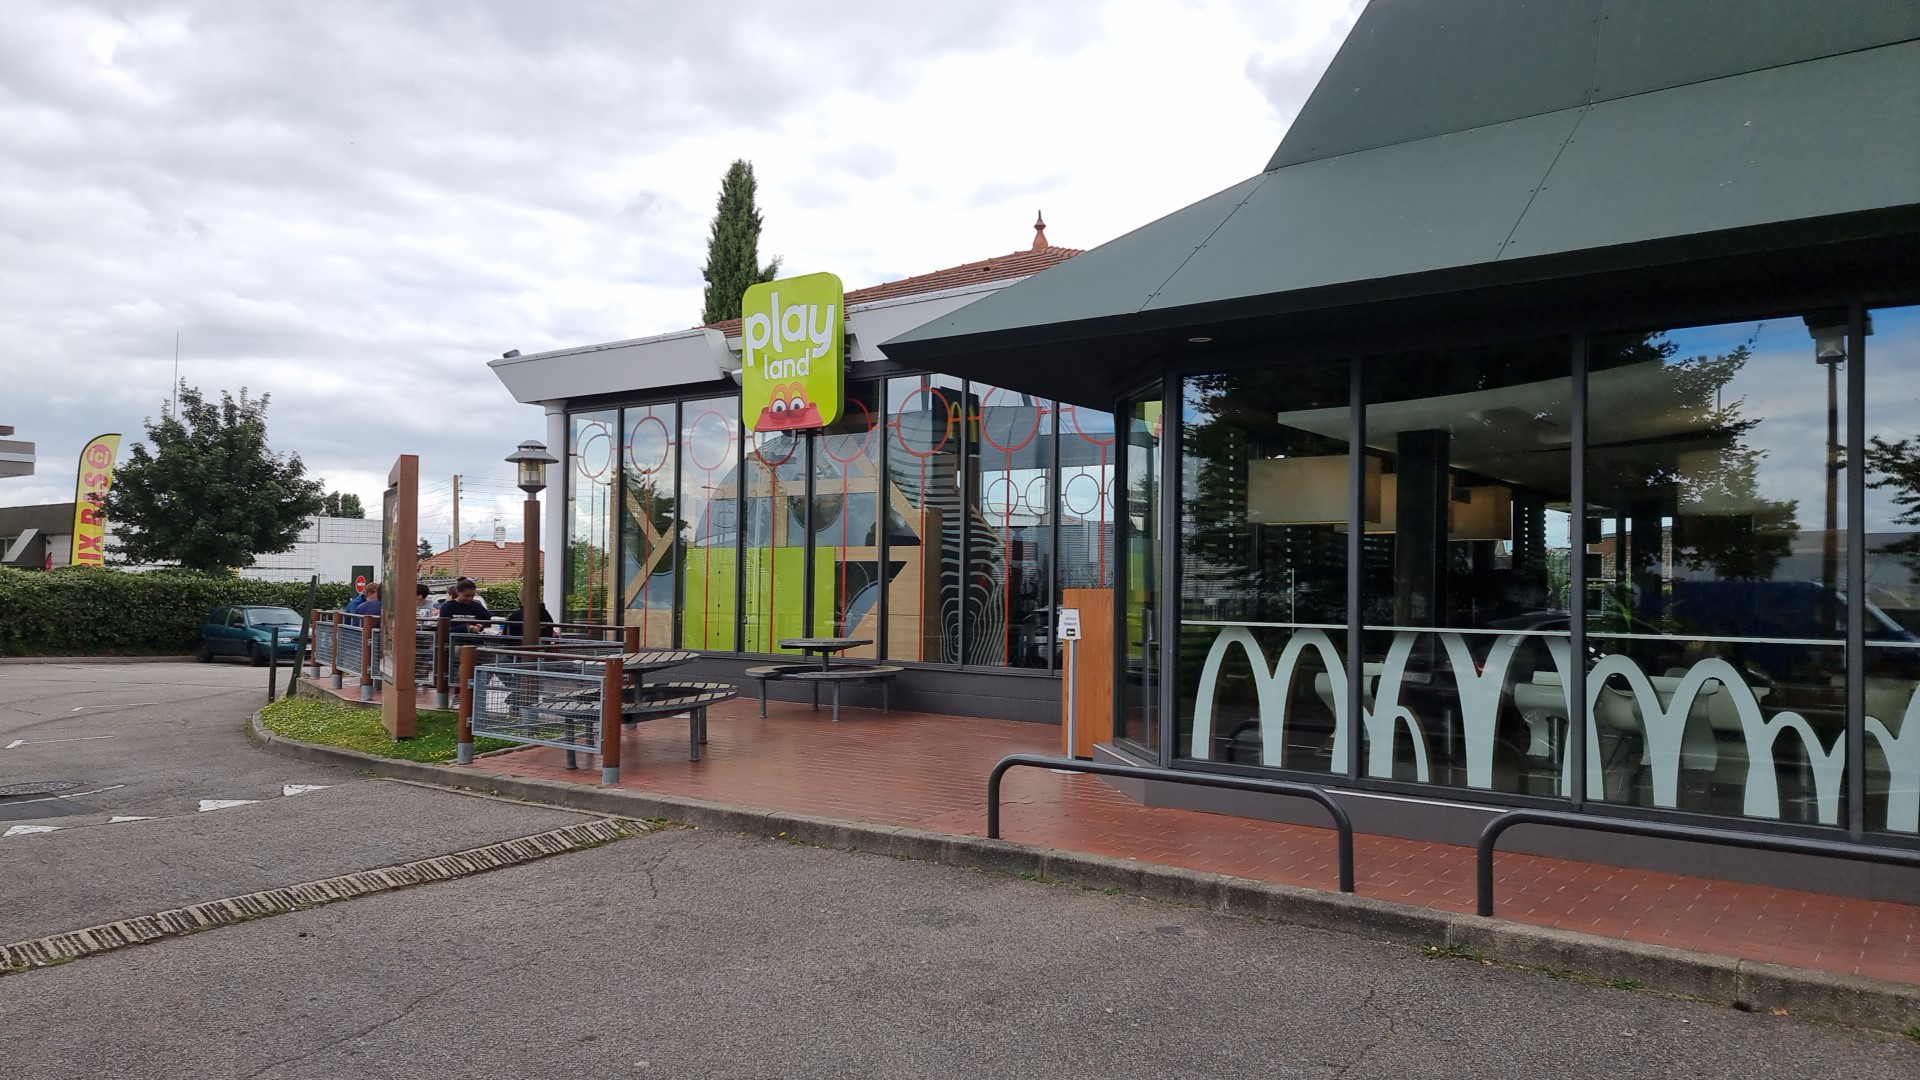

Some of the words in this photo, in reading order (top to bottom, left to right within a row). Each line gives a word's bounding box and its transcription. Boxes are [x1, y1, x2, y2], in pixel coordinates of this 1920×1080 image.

[745, 292, 835, 367] play
[763, 347, 810, 380] land
[88, 447, 110, 465] ici
